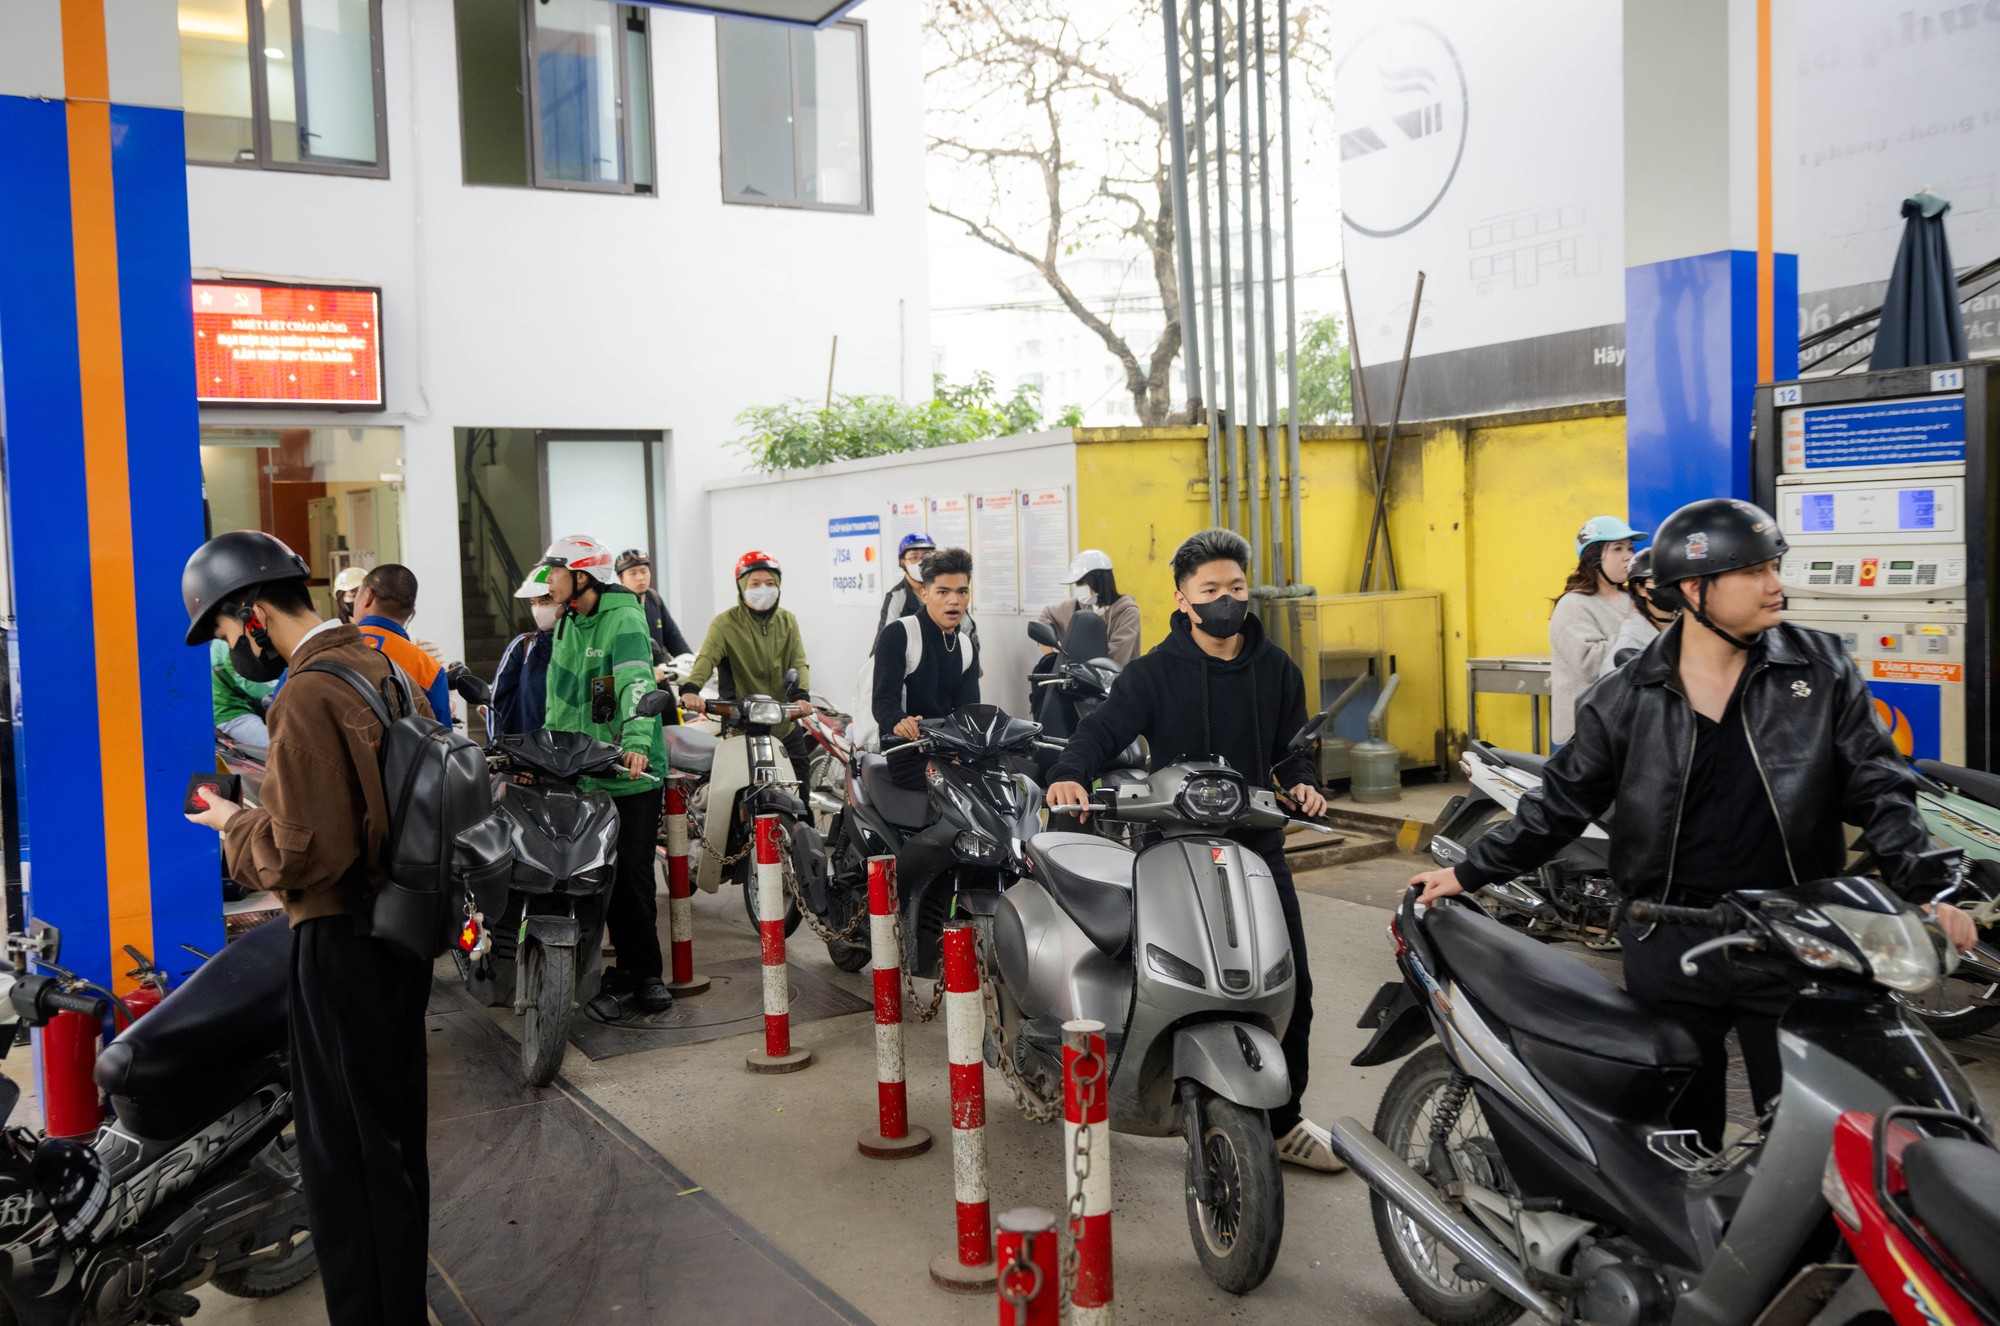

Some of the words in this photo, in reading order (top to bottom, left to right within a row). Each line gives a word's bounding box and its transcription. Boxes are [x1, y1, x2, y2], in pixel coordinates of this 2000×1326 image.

[1938, 373, 1957, 387] 11
[1780, 389, 1797, 403] 12
[833, 575, 857, 592] napas
